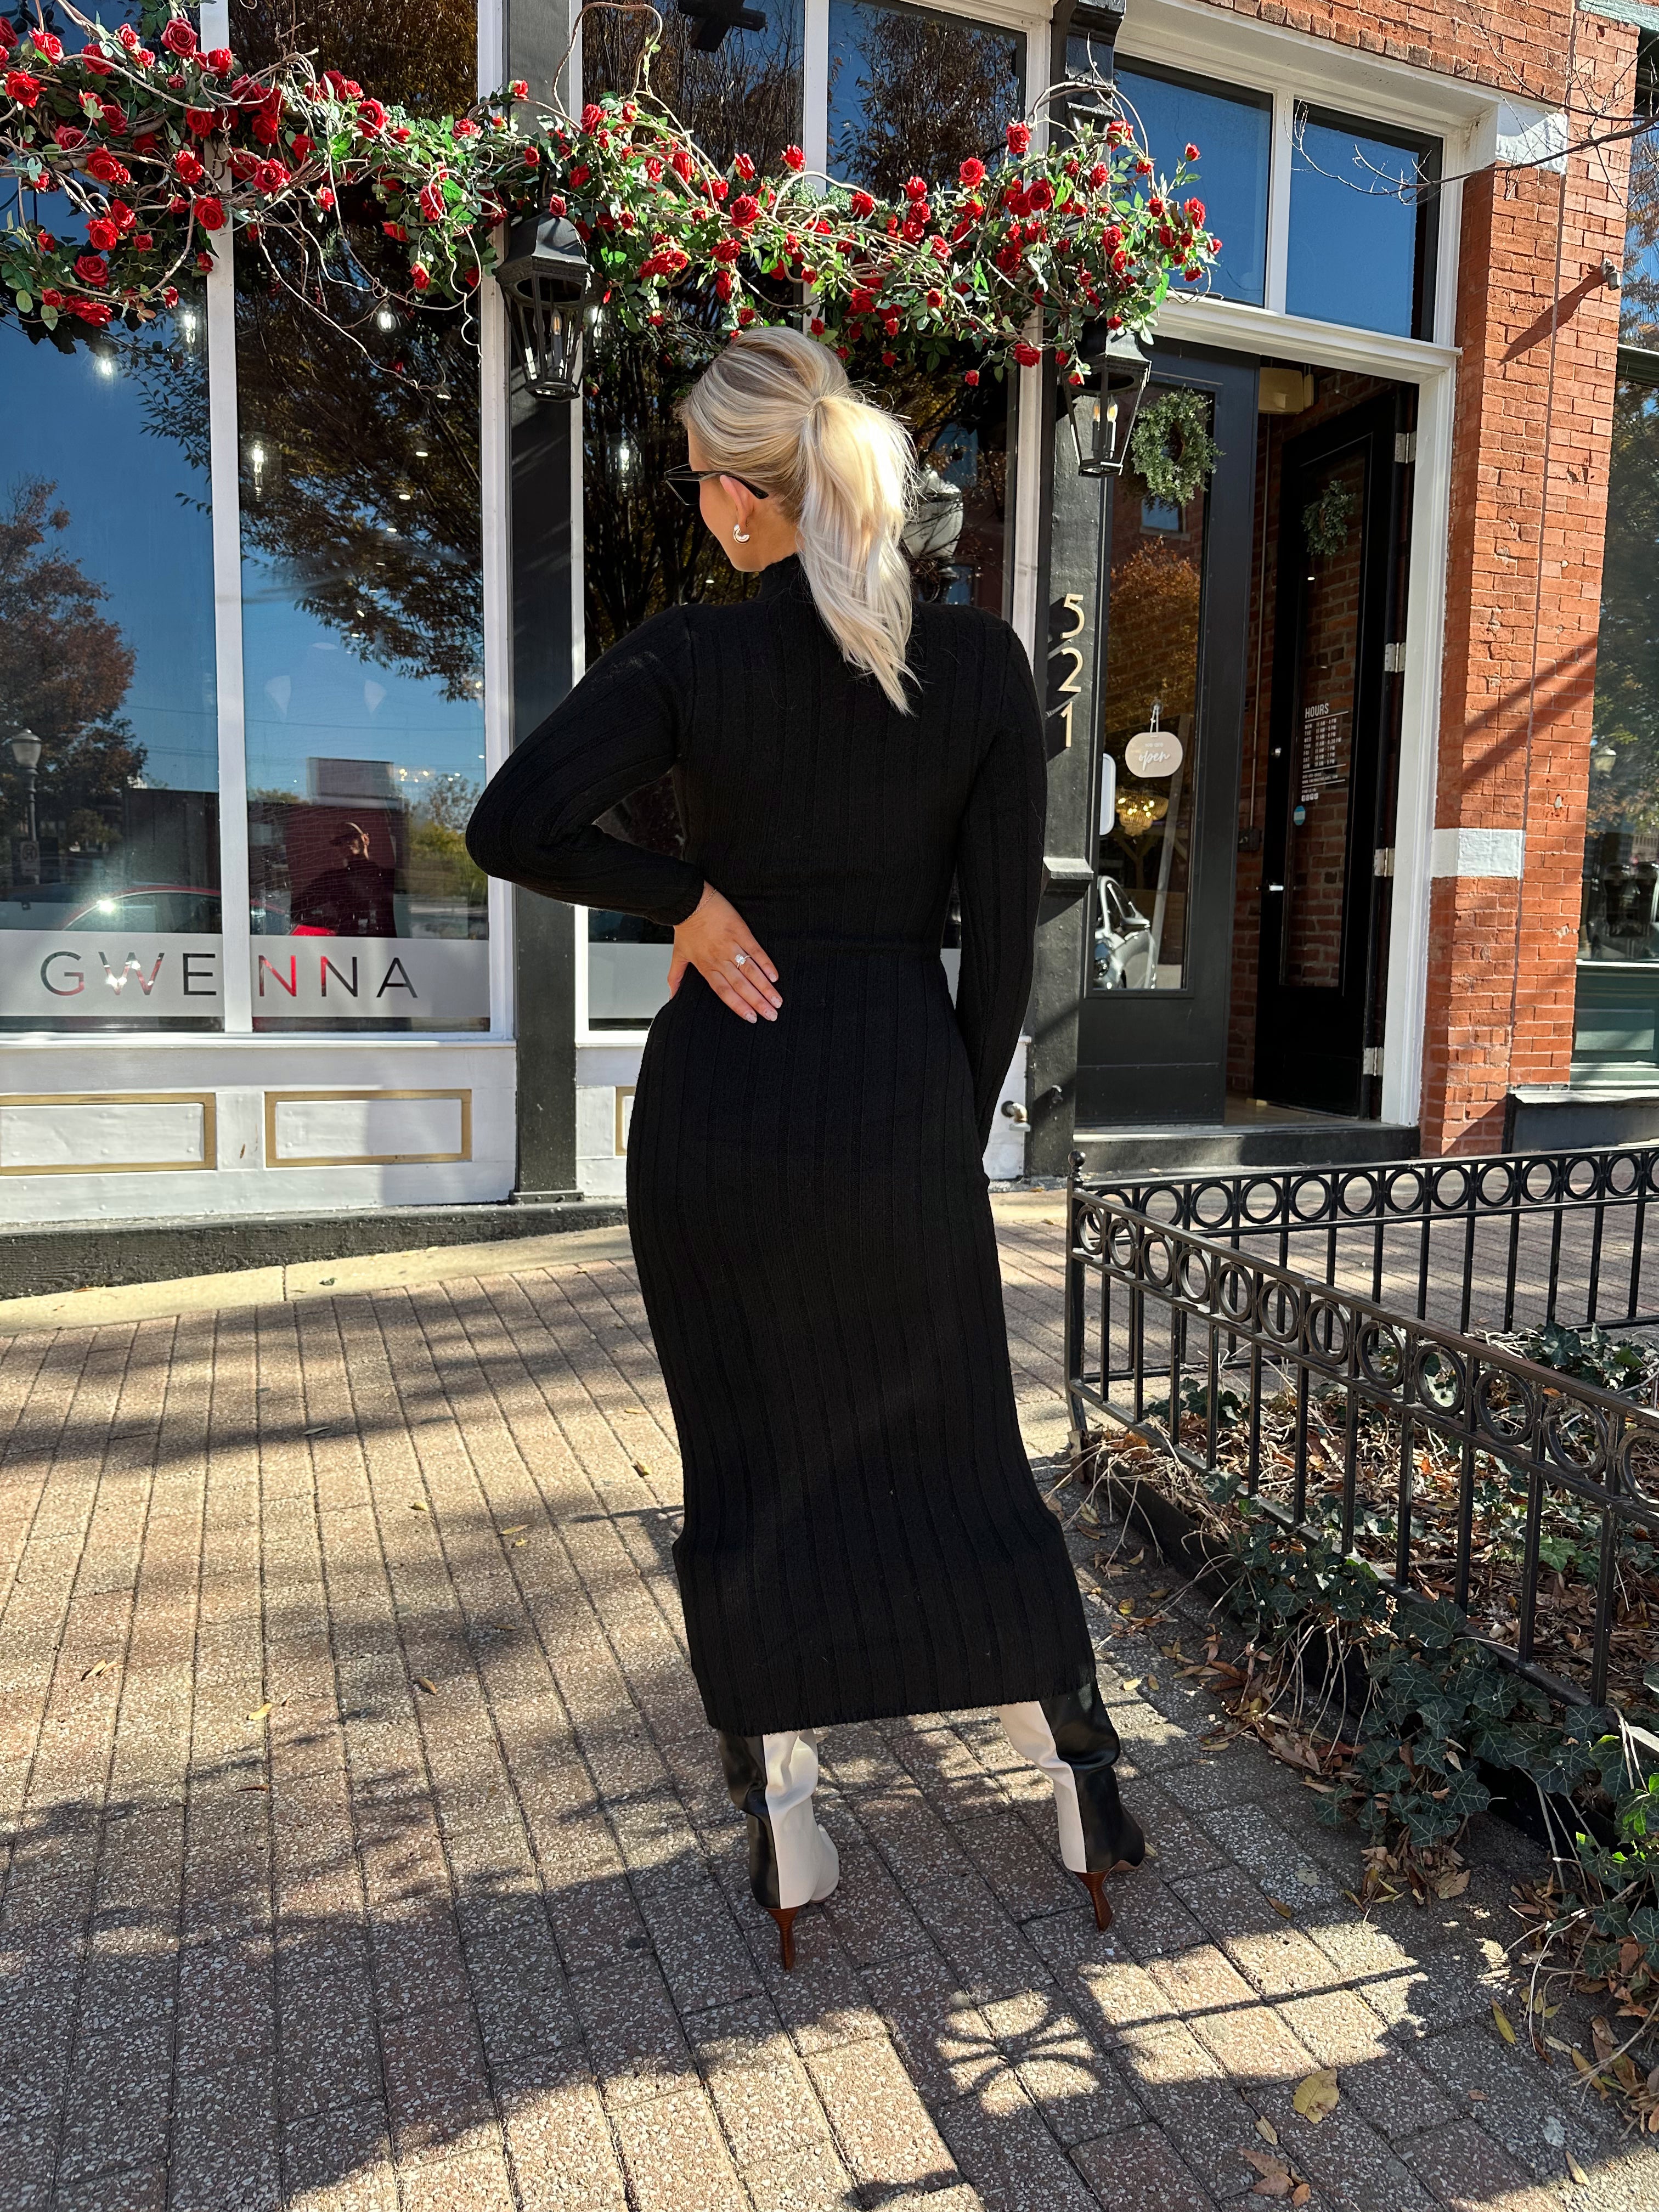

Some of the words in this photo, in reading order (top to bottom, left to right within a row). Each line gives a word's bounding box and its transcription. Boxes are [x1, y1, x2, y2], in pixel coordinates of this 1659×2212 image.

[1058, 593, 1085, 748] 521
[1305, 703, 1329, 719] HOURS
[1138, 751, 1171, 771] open
[40, 951, 419, 998] GWENNA
